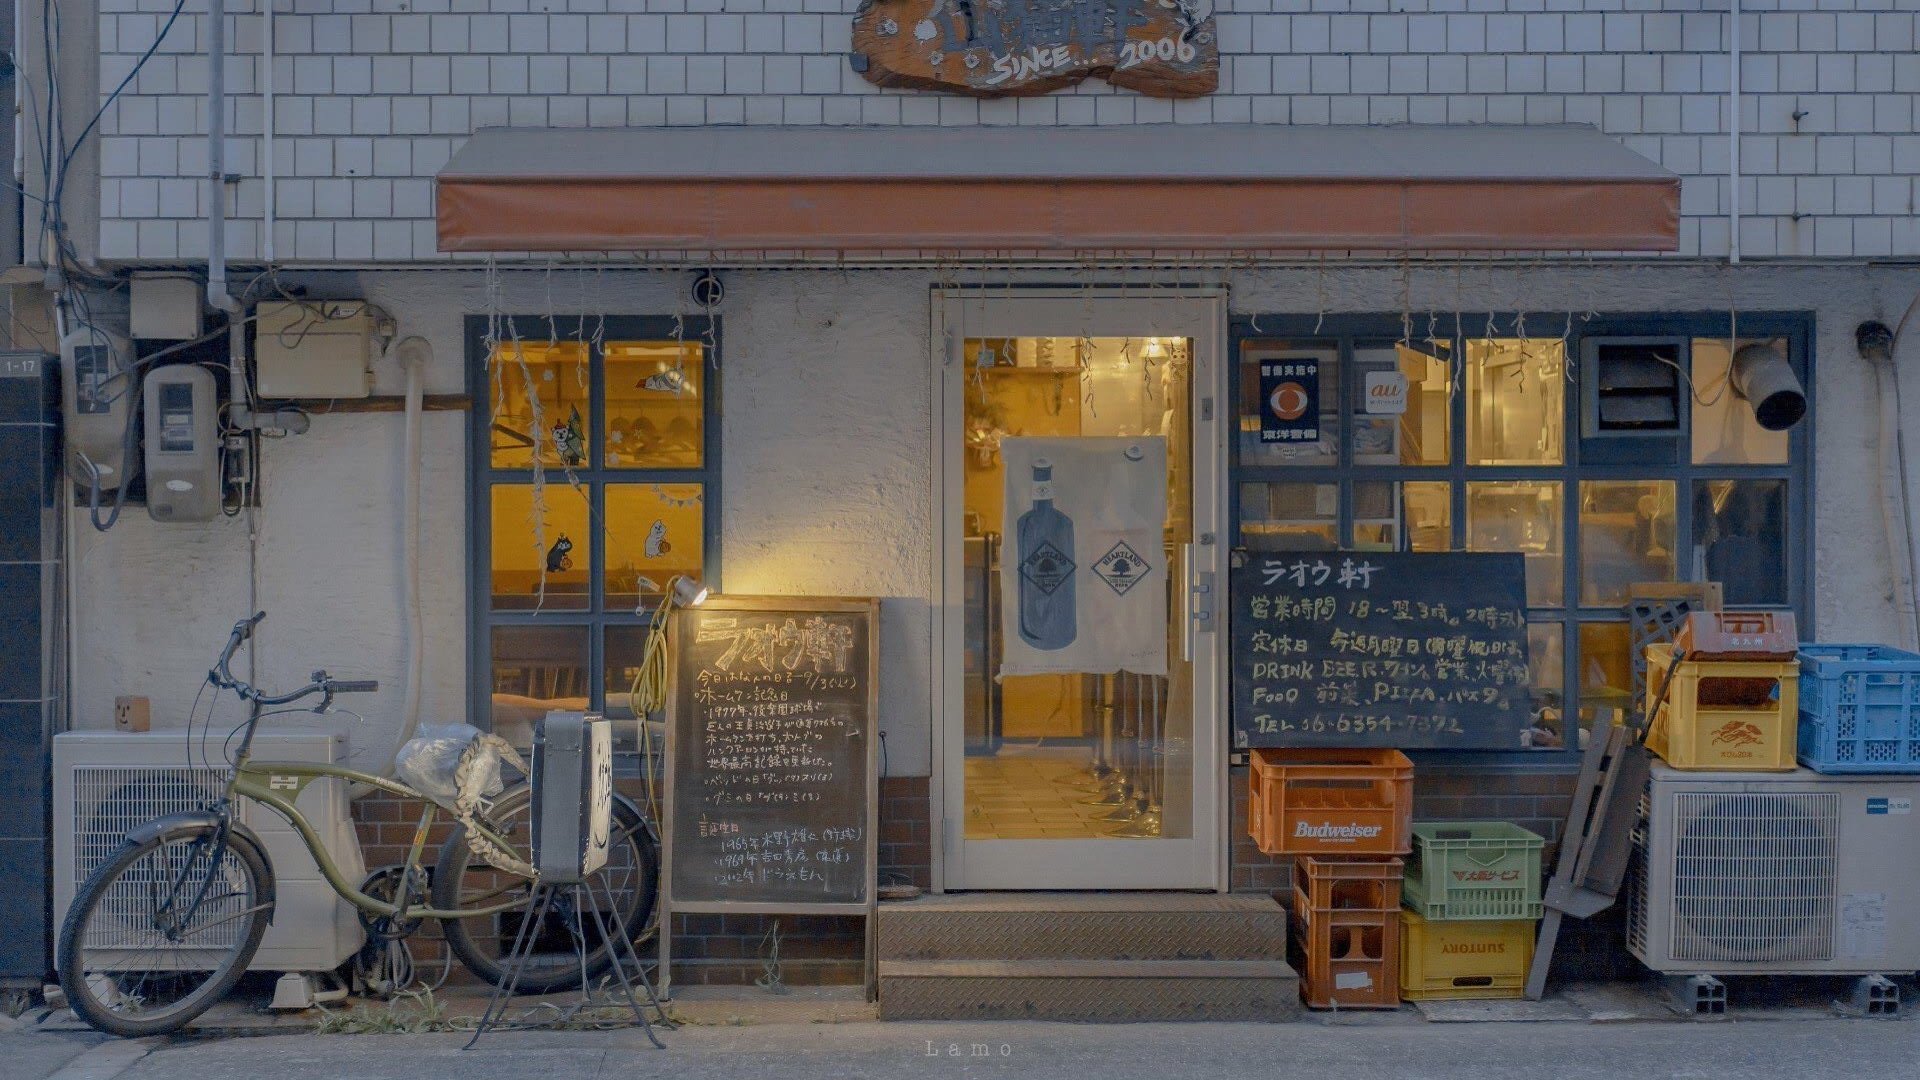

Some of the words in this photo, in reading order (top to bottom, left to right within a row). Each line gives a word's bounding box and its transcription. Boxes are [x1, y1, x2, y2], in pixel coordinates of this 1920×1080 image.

[1119, 26, 1197, 69] 2006
[6, 360, 36, 373] 1-17
[1370, 384, 1401, 397] au
[1102, 550, 1141, 567] HEARTLAND
[1261, 558, 1385, 590] ラオウ軒
[1251, 595, 1336, 622] 営業時間
[1252, 629, 1308, 655] 定休日
[1253, 662, 1314, 680] DRINK
[1254, 714, 1295, 734] TEL
[699, 813, 740, 838] 誕生日
[1294, 821, 1383, 838] Budweiser
[1441, 943, 1506, 954] SUNTORY
